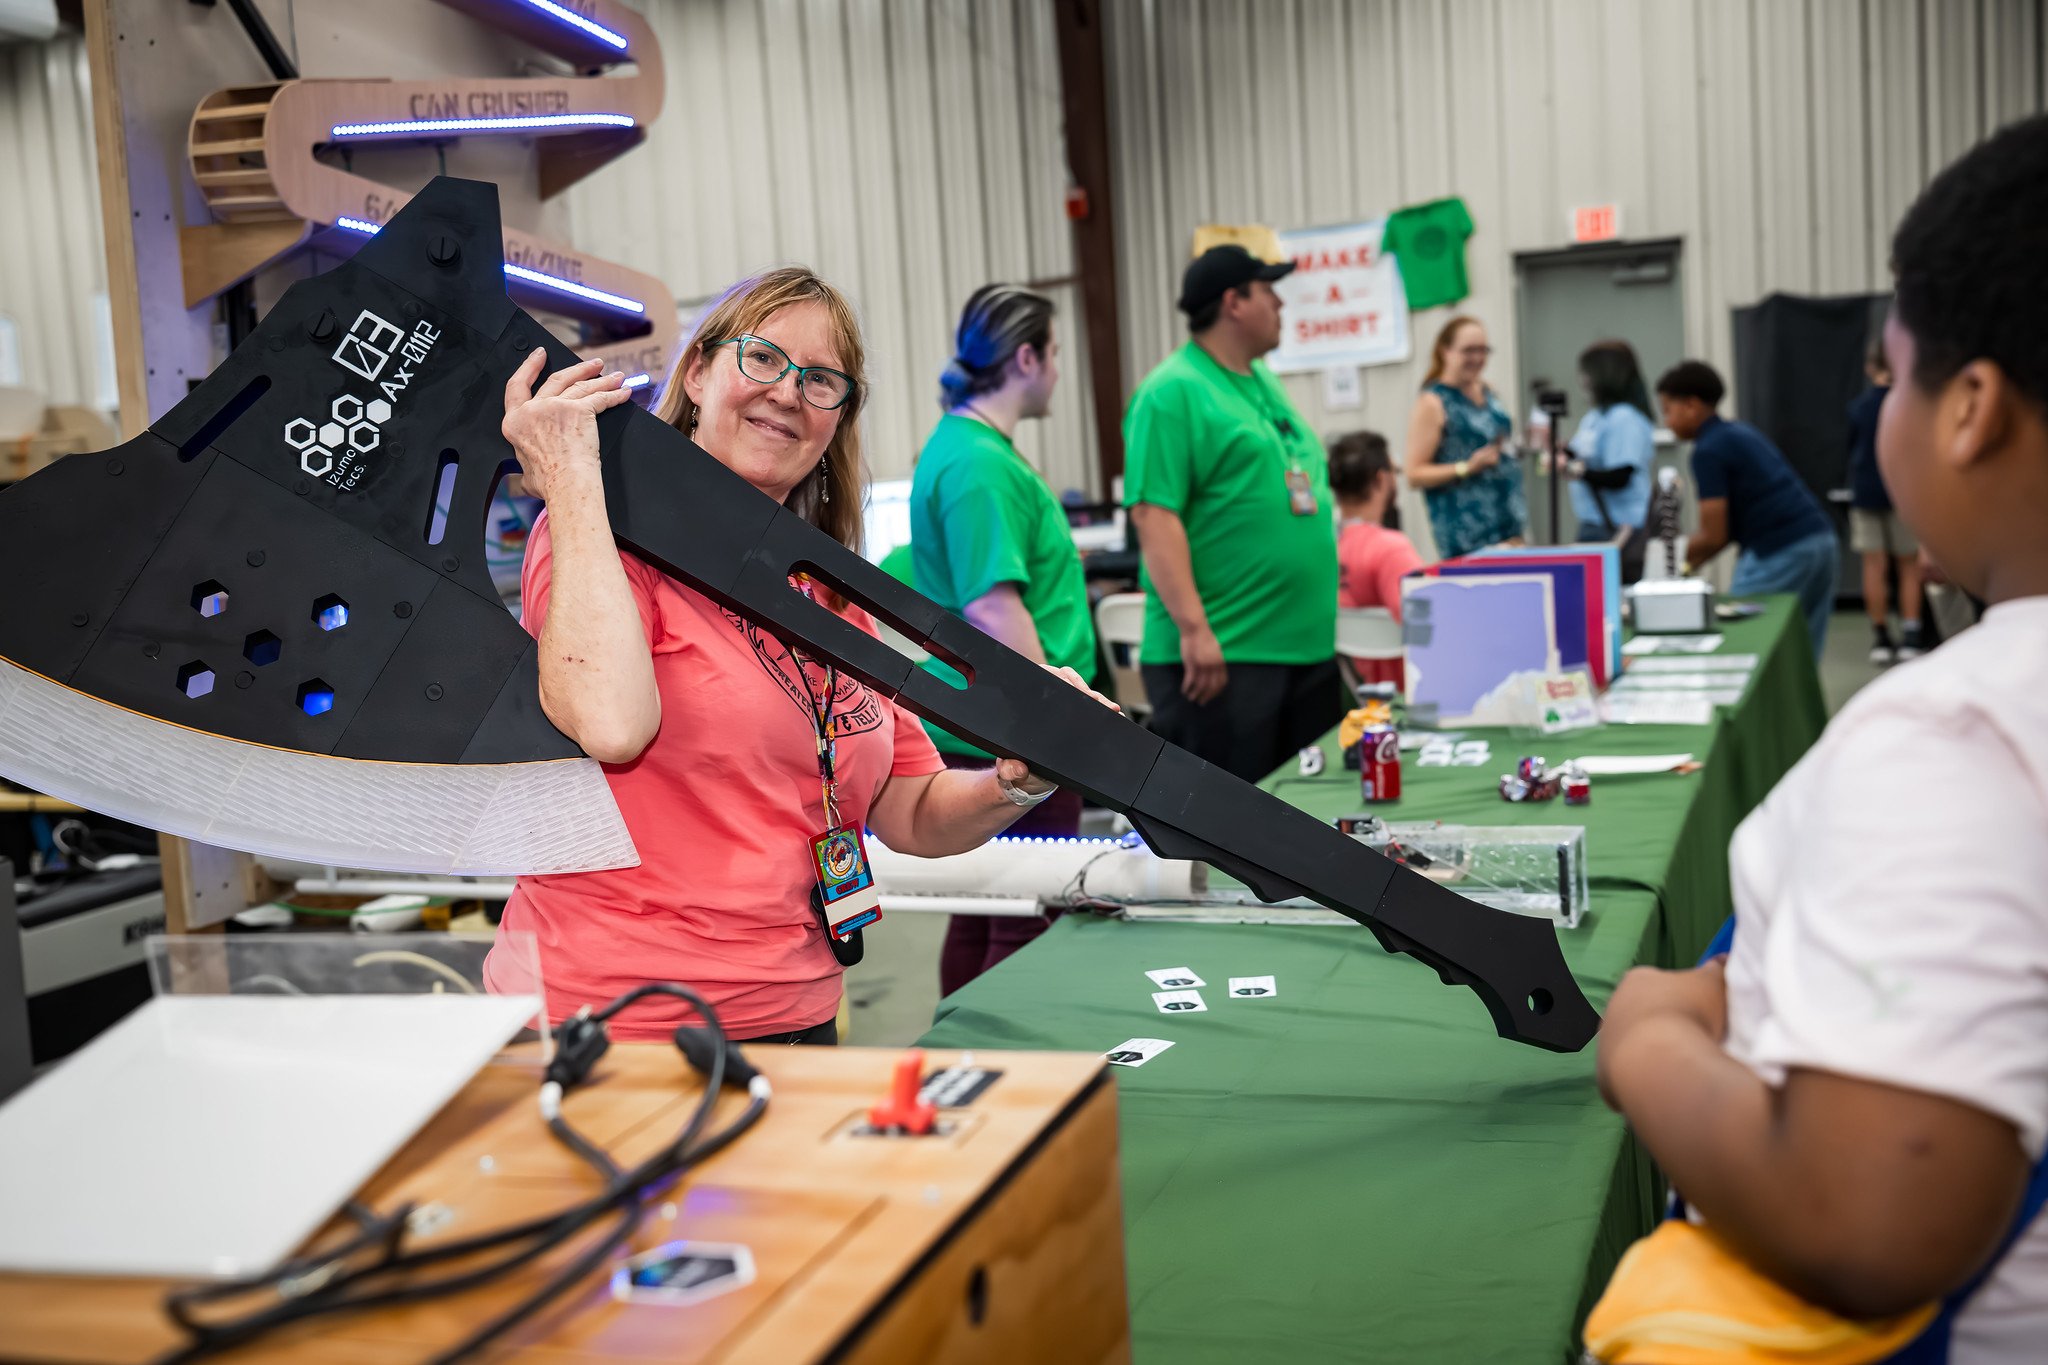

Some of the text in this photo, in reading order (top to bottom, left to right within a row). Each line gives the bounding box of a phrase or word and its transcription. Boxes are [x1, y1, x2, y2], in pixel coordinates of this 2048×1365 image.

[409, 89, 570, 120] CAN CRUSHER
[1290, 245, 1377, 274] MAKE
[1325, 284, 1343, 304] A
[1295, 310, 1379, 343] SHIRT
[325, 449, 357, 486] Izumo
[835, 878, 860, 895] CREW
